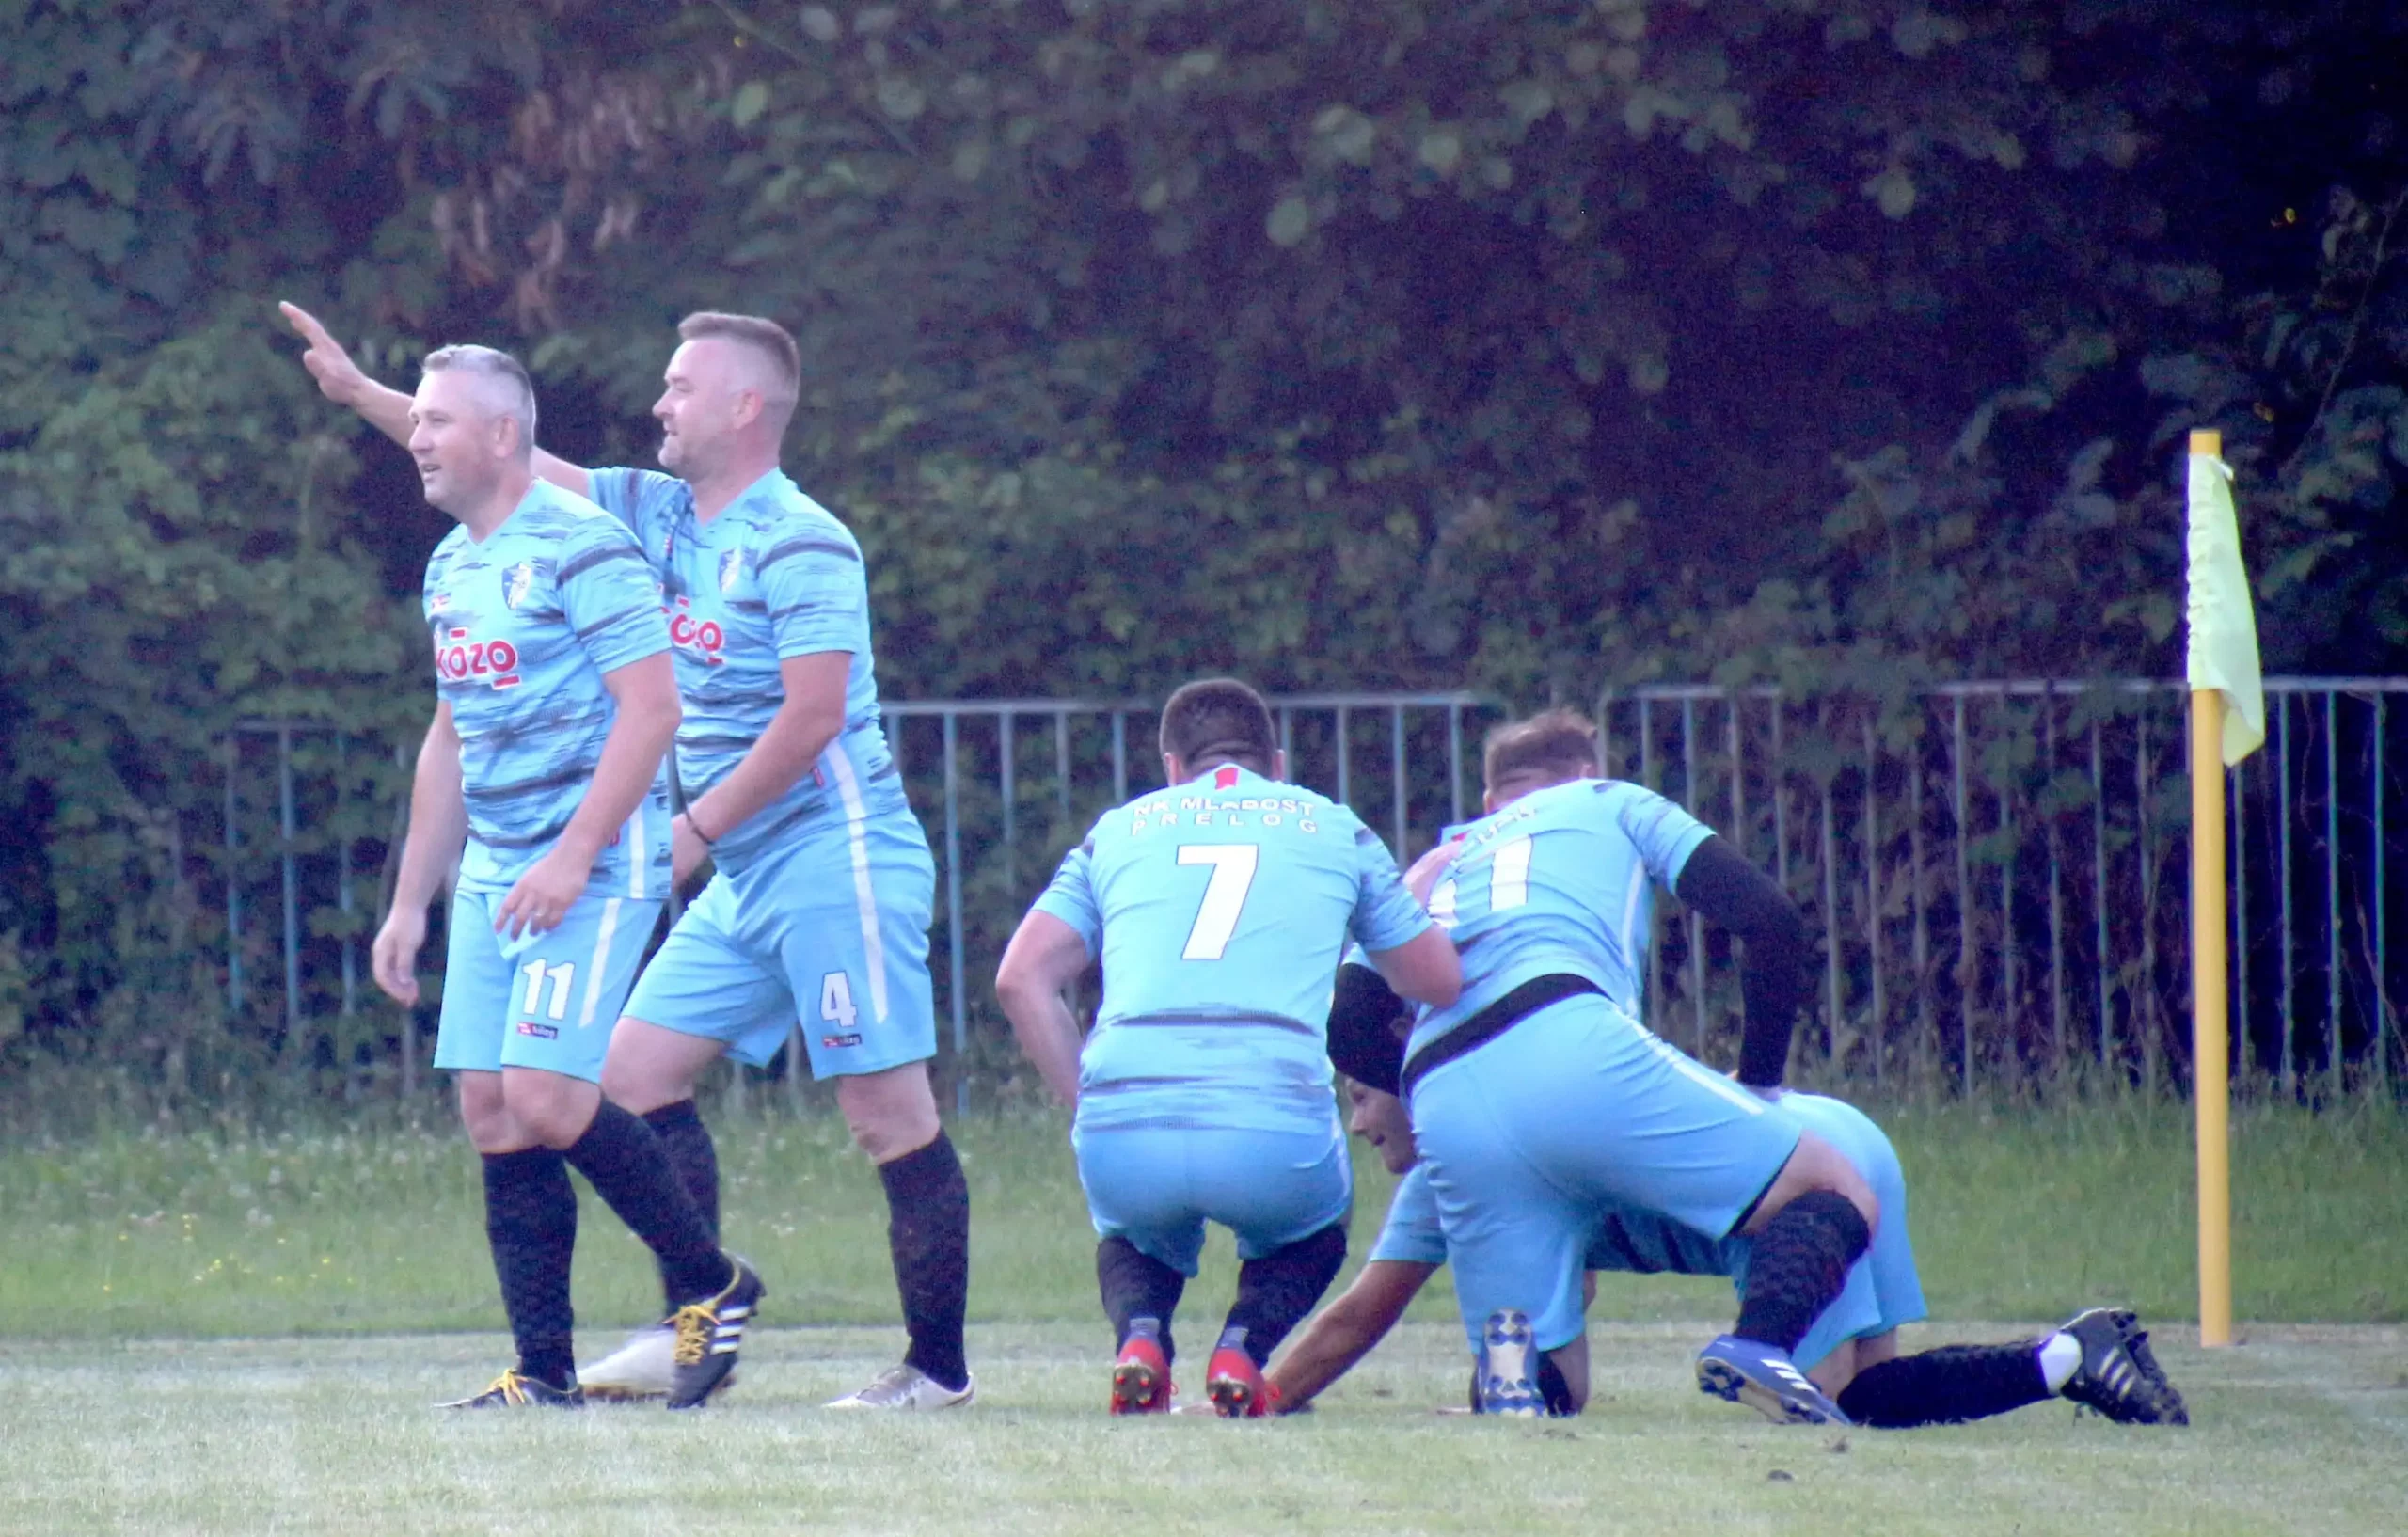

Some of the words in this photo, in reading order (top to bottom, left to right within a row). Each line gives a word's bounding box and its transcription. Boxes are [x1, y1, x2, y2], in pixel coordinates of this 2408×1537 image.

[1131, 813, 1317, 836] PRELOG
[1176, 844, 1259, 960] 7
[522, 958, 576, 1021] 11
[819, 970, 858, 1027] 4
